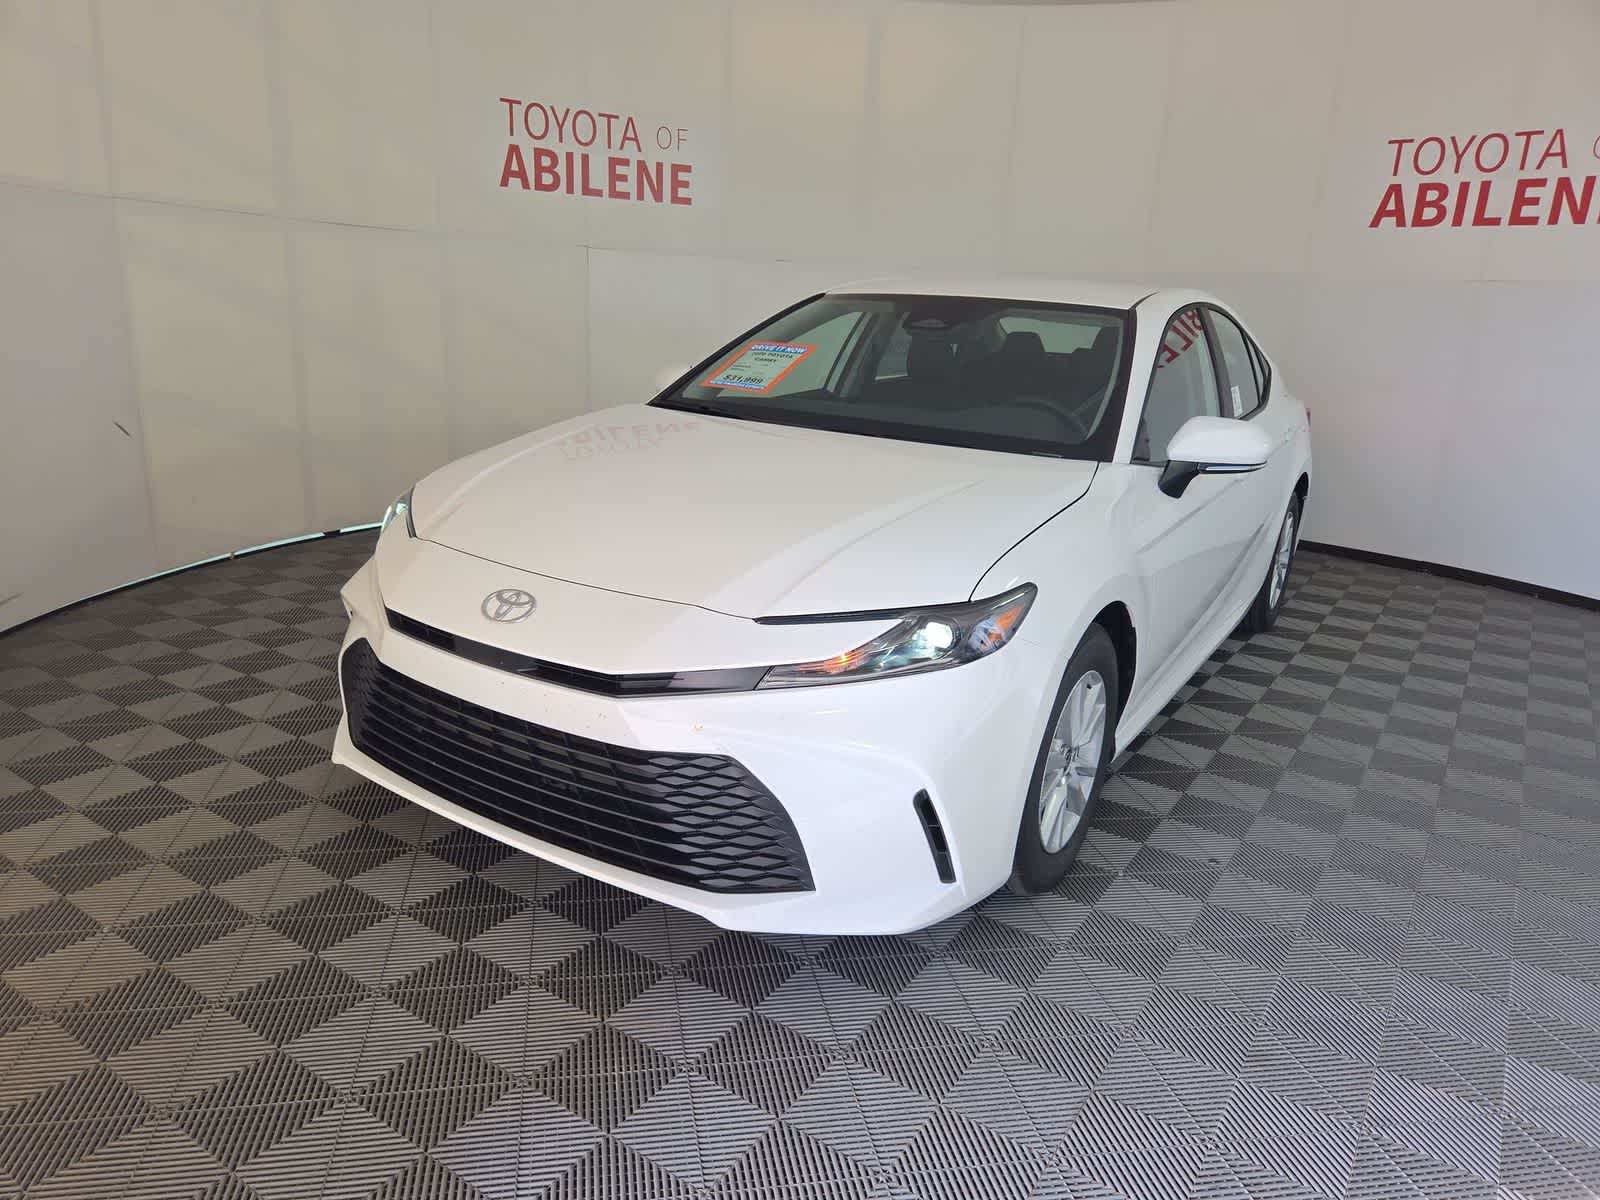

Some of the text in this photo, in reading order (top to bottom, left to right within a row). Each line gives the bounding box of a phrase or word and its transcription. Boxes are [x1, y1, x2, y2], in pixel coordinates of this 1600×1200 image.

[500, 98, 689, 153] TOYOTA OF
[1388, 128, 1568, 176] TOYOTA
[500, 144, 692, 205] ABILENE
[1369, 176, 1600, 228] ABILEN
